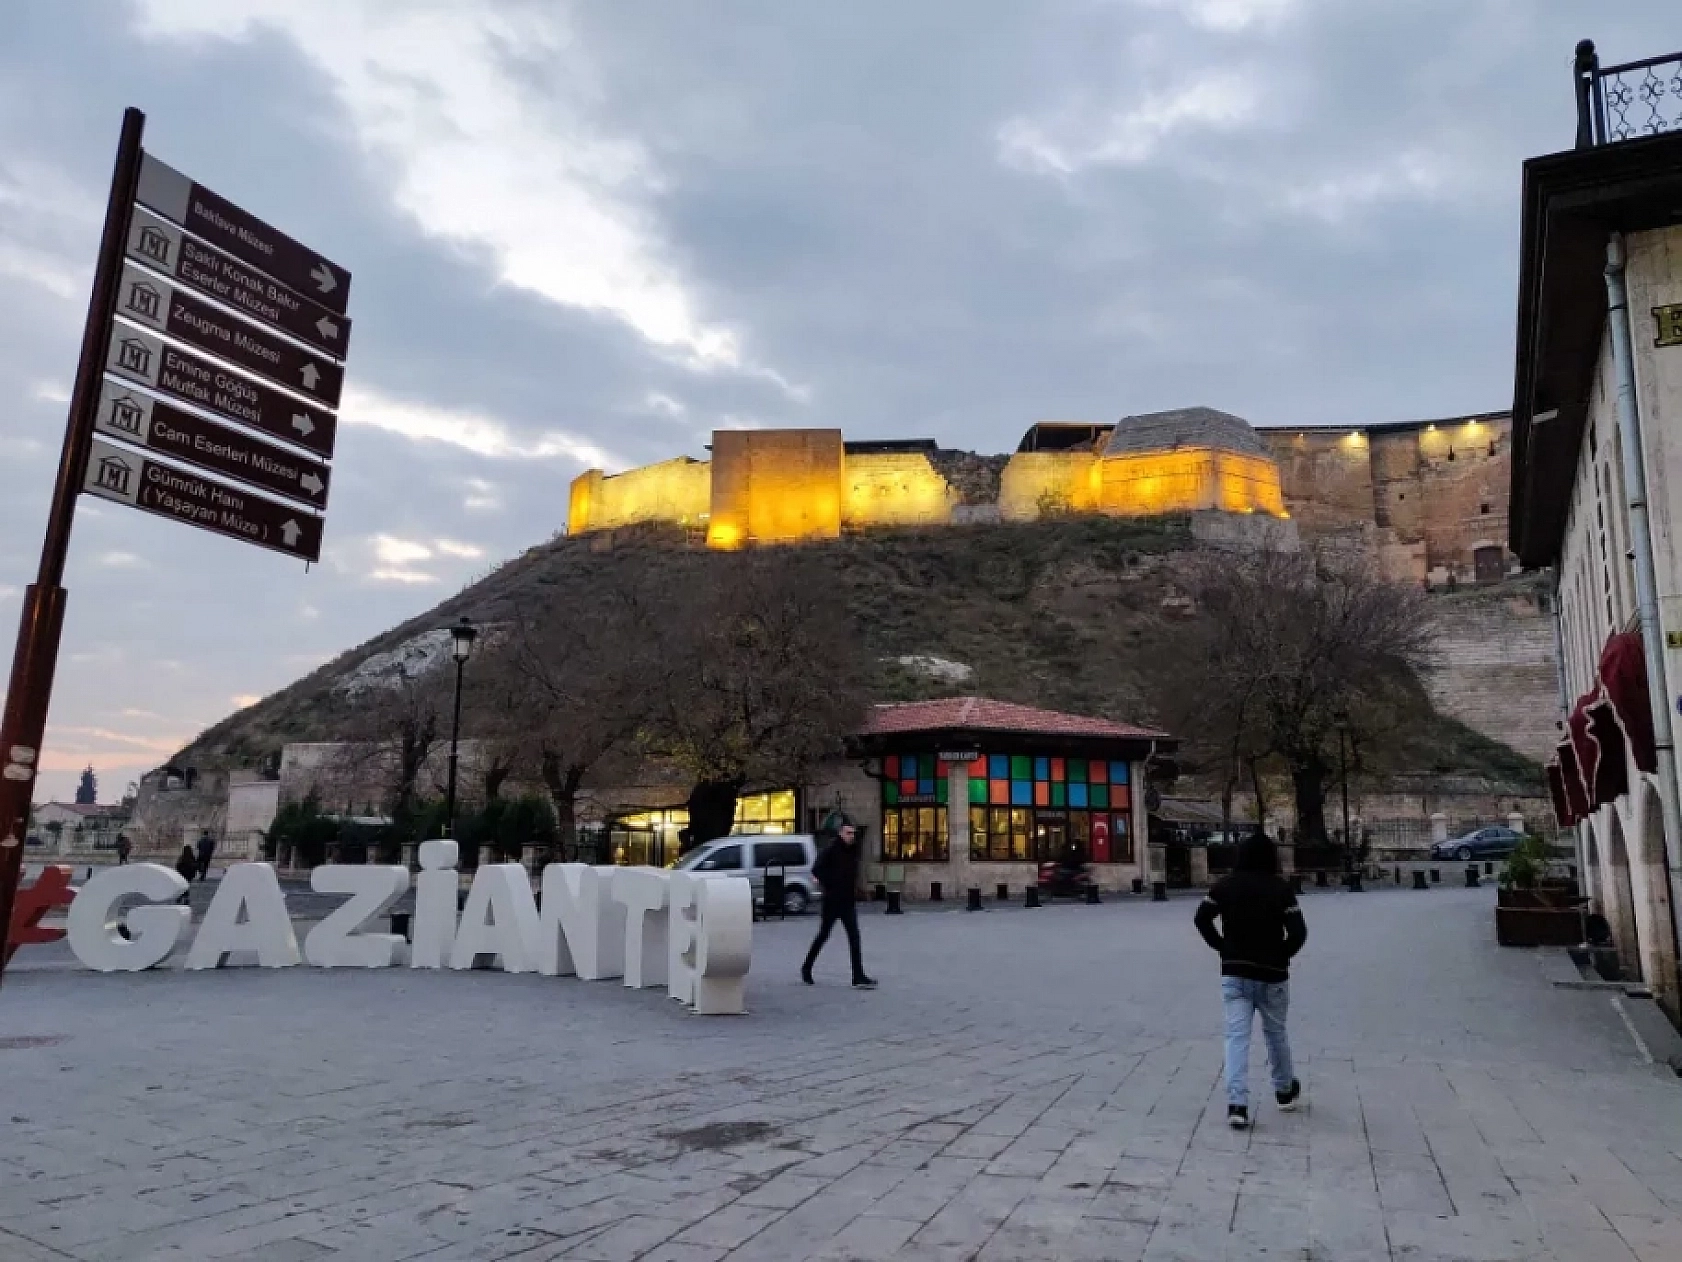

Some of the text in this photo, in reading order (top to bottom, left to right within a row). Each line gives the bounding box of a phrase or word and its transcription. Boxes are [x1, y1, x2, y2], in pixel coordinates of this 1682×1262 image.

[181, 260, 279, 320] Eserler Müzesi
[223, 262, 264, 295] Konak
[172, 303, 281, 364] Zeugma Müzesi
[167, 352, 211, 381] Emine
[162, 371, 262, 422] Mutfak Müzesi
[154, 420, 191, 445] Cam
[251, 453, 299, 480] Müzesi
[147, 466, 207, 498] Gümrük
[155, 488, 218, 522] Yaşayan
[220, 510, 259, 534] Müze
